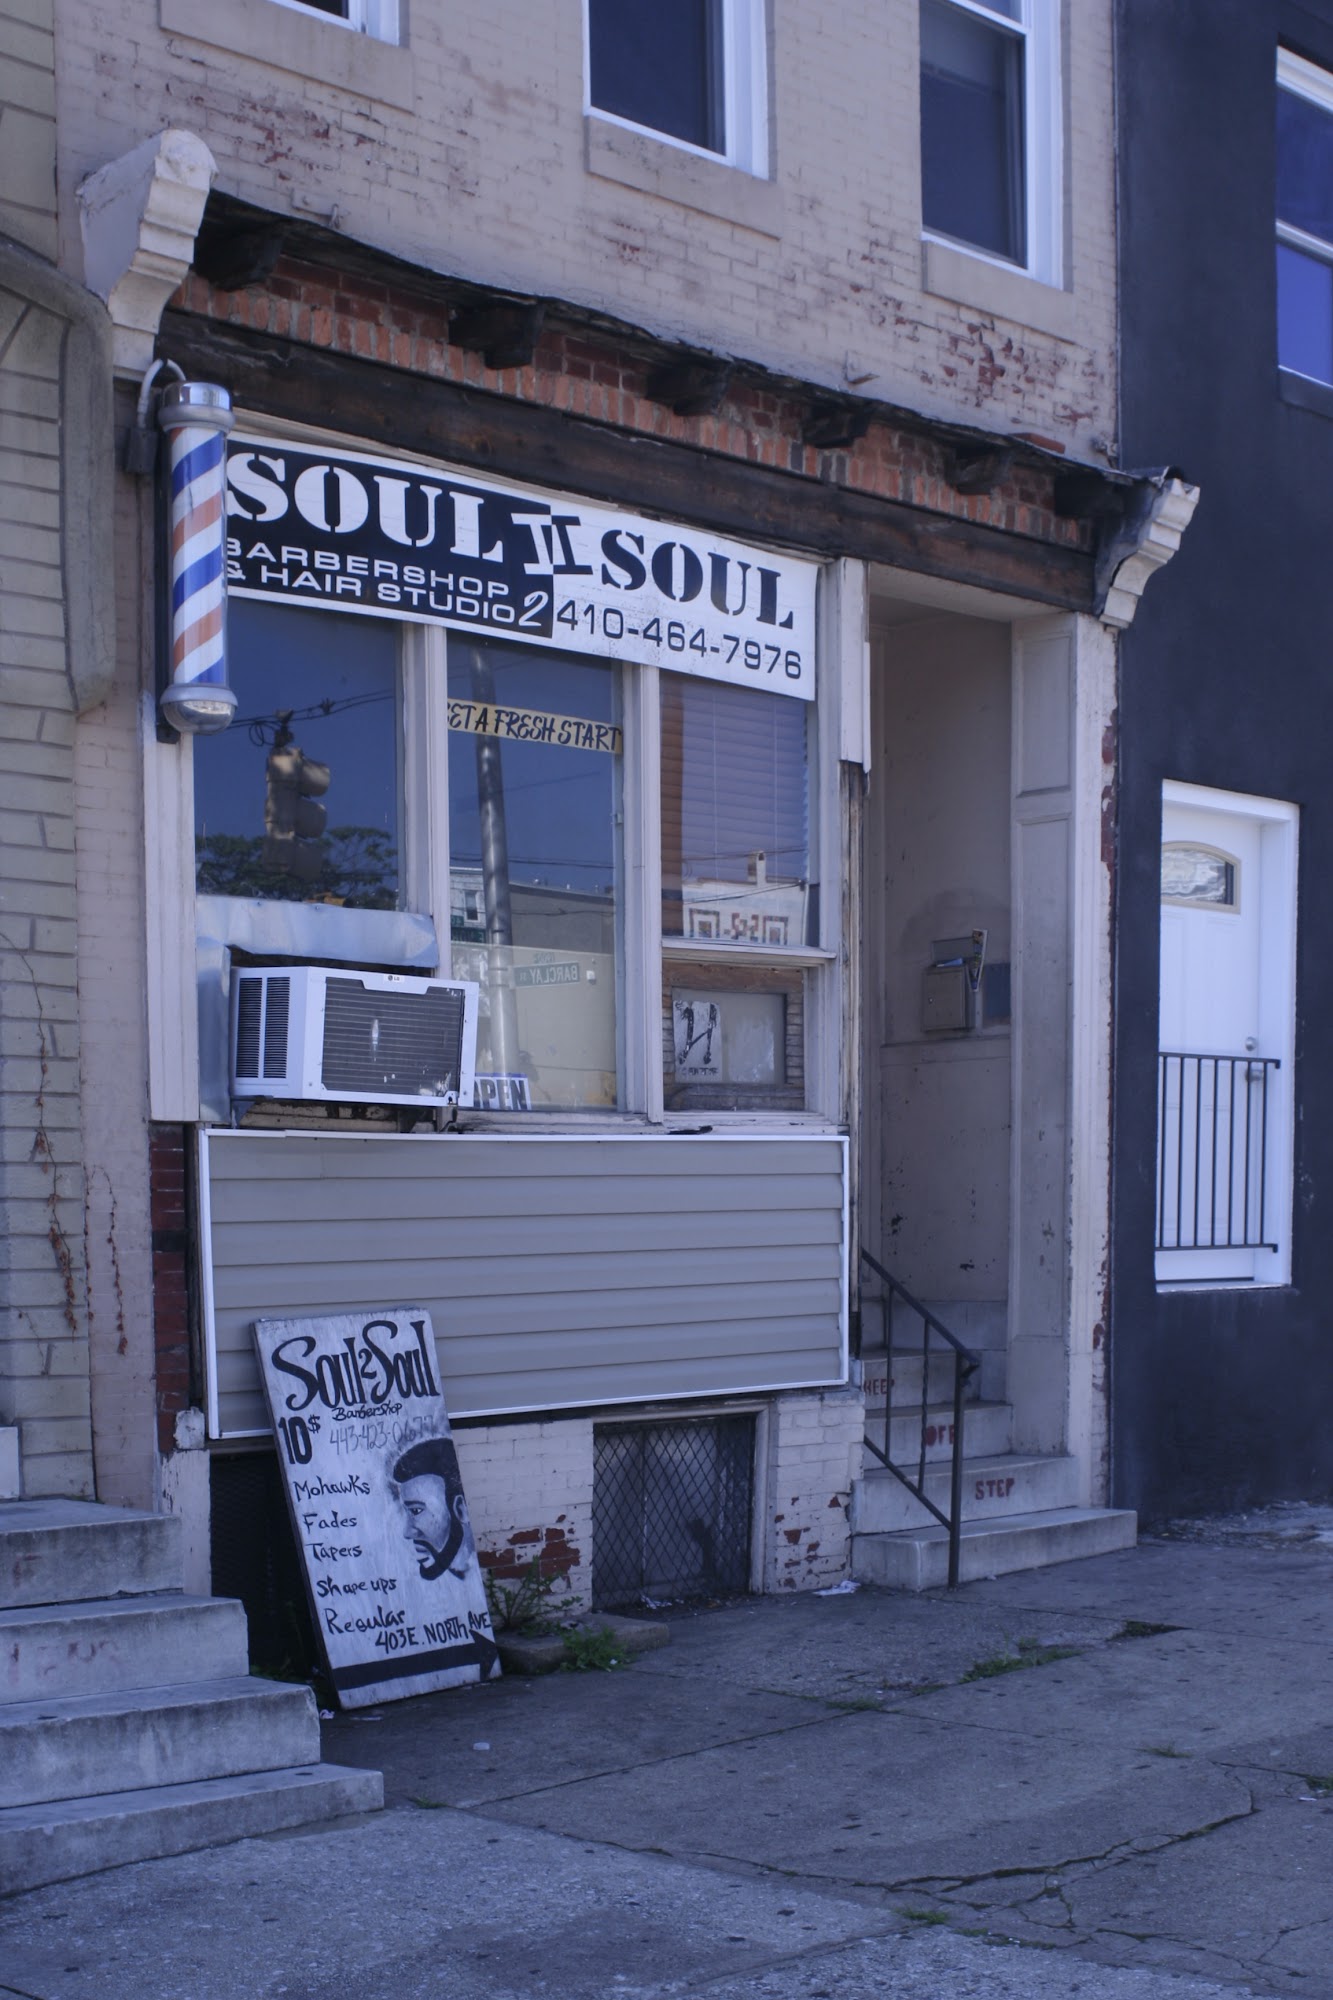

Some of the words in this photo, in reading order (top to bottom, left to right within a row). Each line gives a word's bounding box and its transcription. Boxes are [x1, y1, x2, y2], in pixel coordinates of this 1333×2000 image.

[226, 452, 503, 563] SOUL
[511, 512, 593, 575] II
[601, 529, 793, 630] SOUL
[227, 537, 509, 598] BARBERSHOP
[227, 560, 246, 580] &
[261, 565, 362, 596] HAIR
[378, 583, 515, 624] STUDIO
[556, 600, 801, 680] 410-464-7976
[447, 702, 476, 730] ET
[474, 707, 489, 733] A
[494, 708, 556, 743] FRESH
[557, 720, 622, 750] START
[975, 1477, 1015, 1500] STEP
[303, 1510, 357, 1534] Fades
[305, 1542, 362, 1562] Tapers
[324, 1605, 405, 1635] Regular
[468, 1610, 491, 1630] AVE
